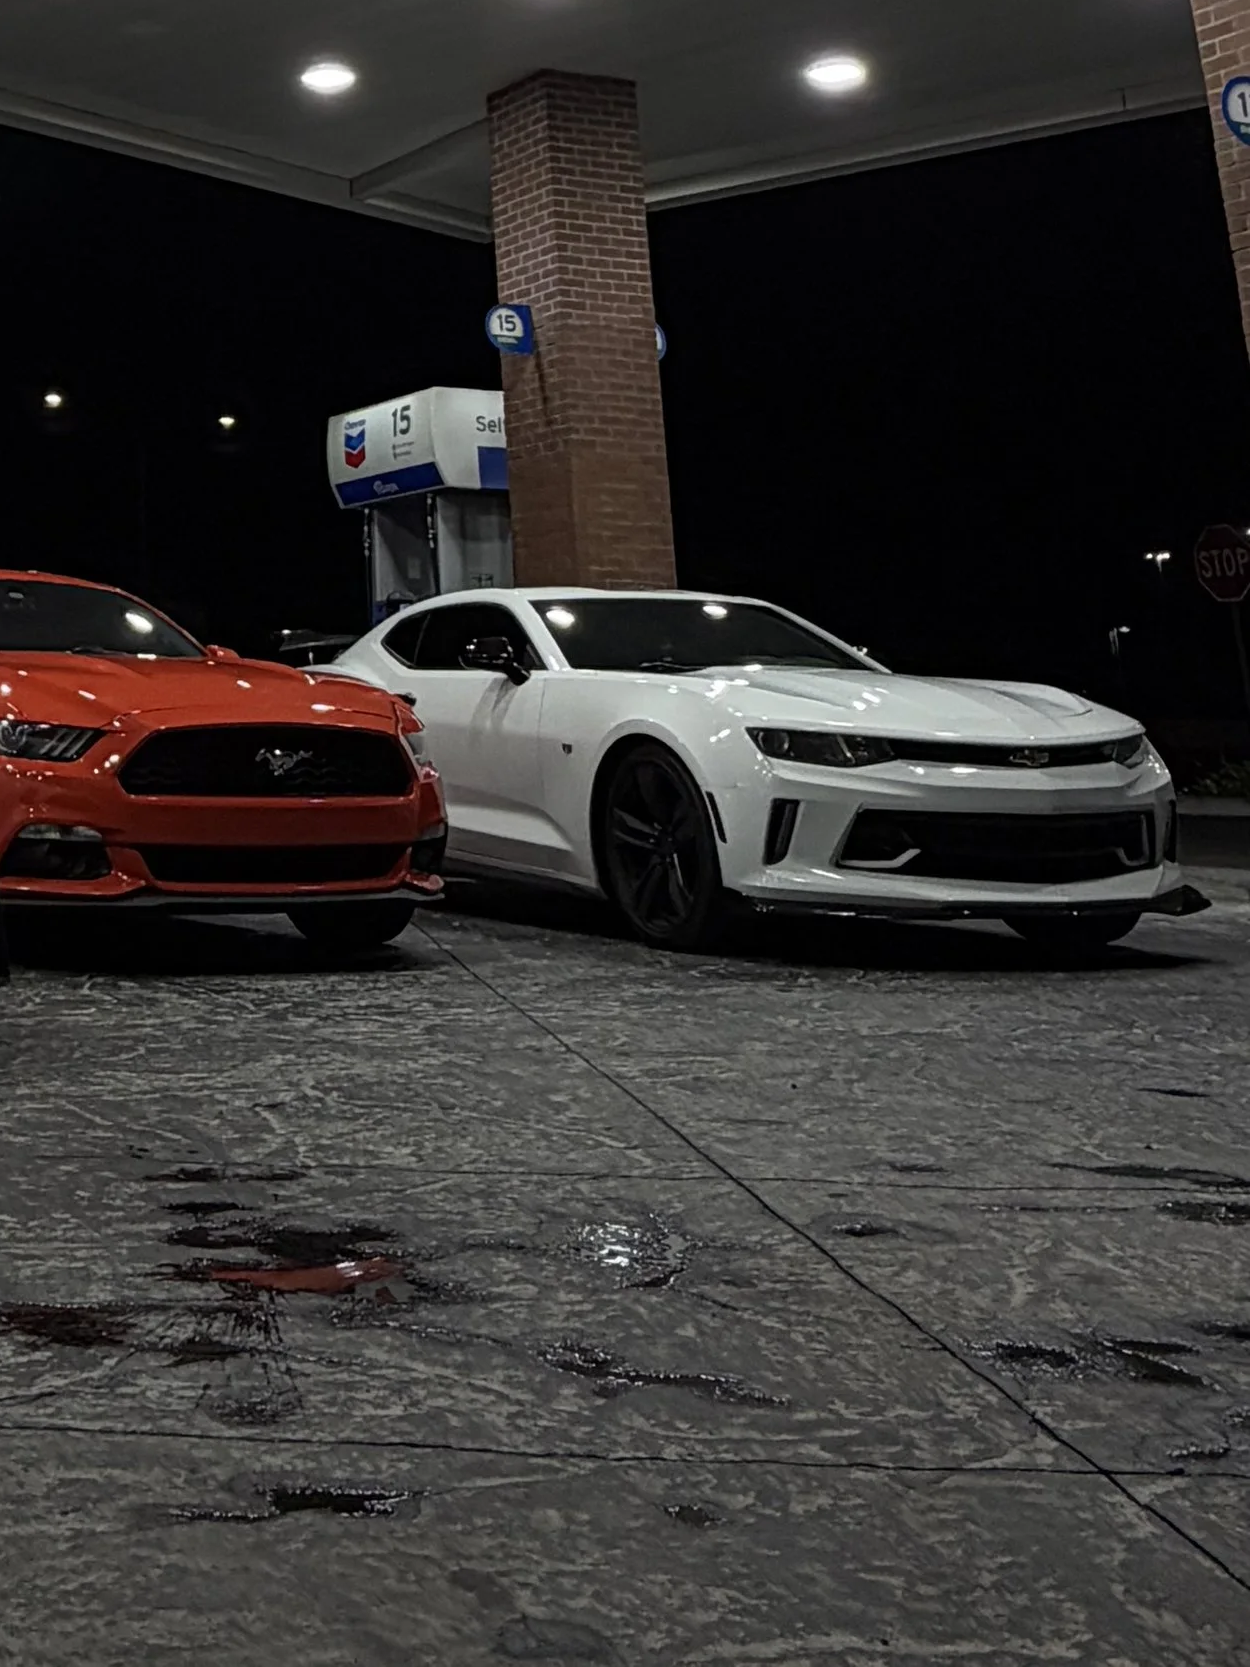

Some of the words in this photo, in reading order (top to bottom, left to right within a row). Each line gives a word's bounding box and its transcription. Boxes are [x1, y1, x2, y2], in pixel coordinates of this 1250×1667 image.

[1237, 91, 1250, 117] 1
[496, 313, 517, 332] 15
[391, 404, 412, 438] 15
[476, 415, 504, 433] Sel
[1198, 546, 1250, 578] STOP
